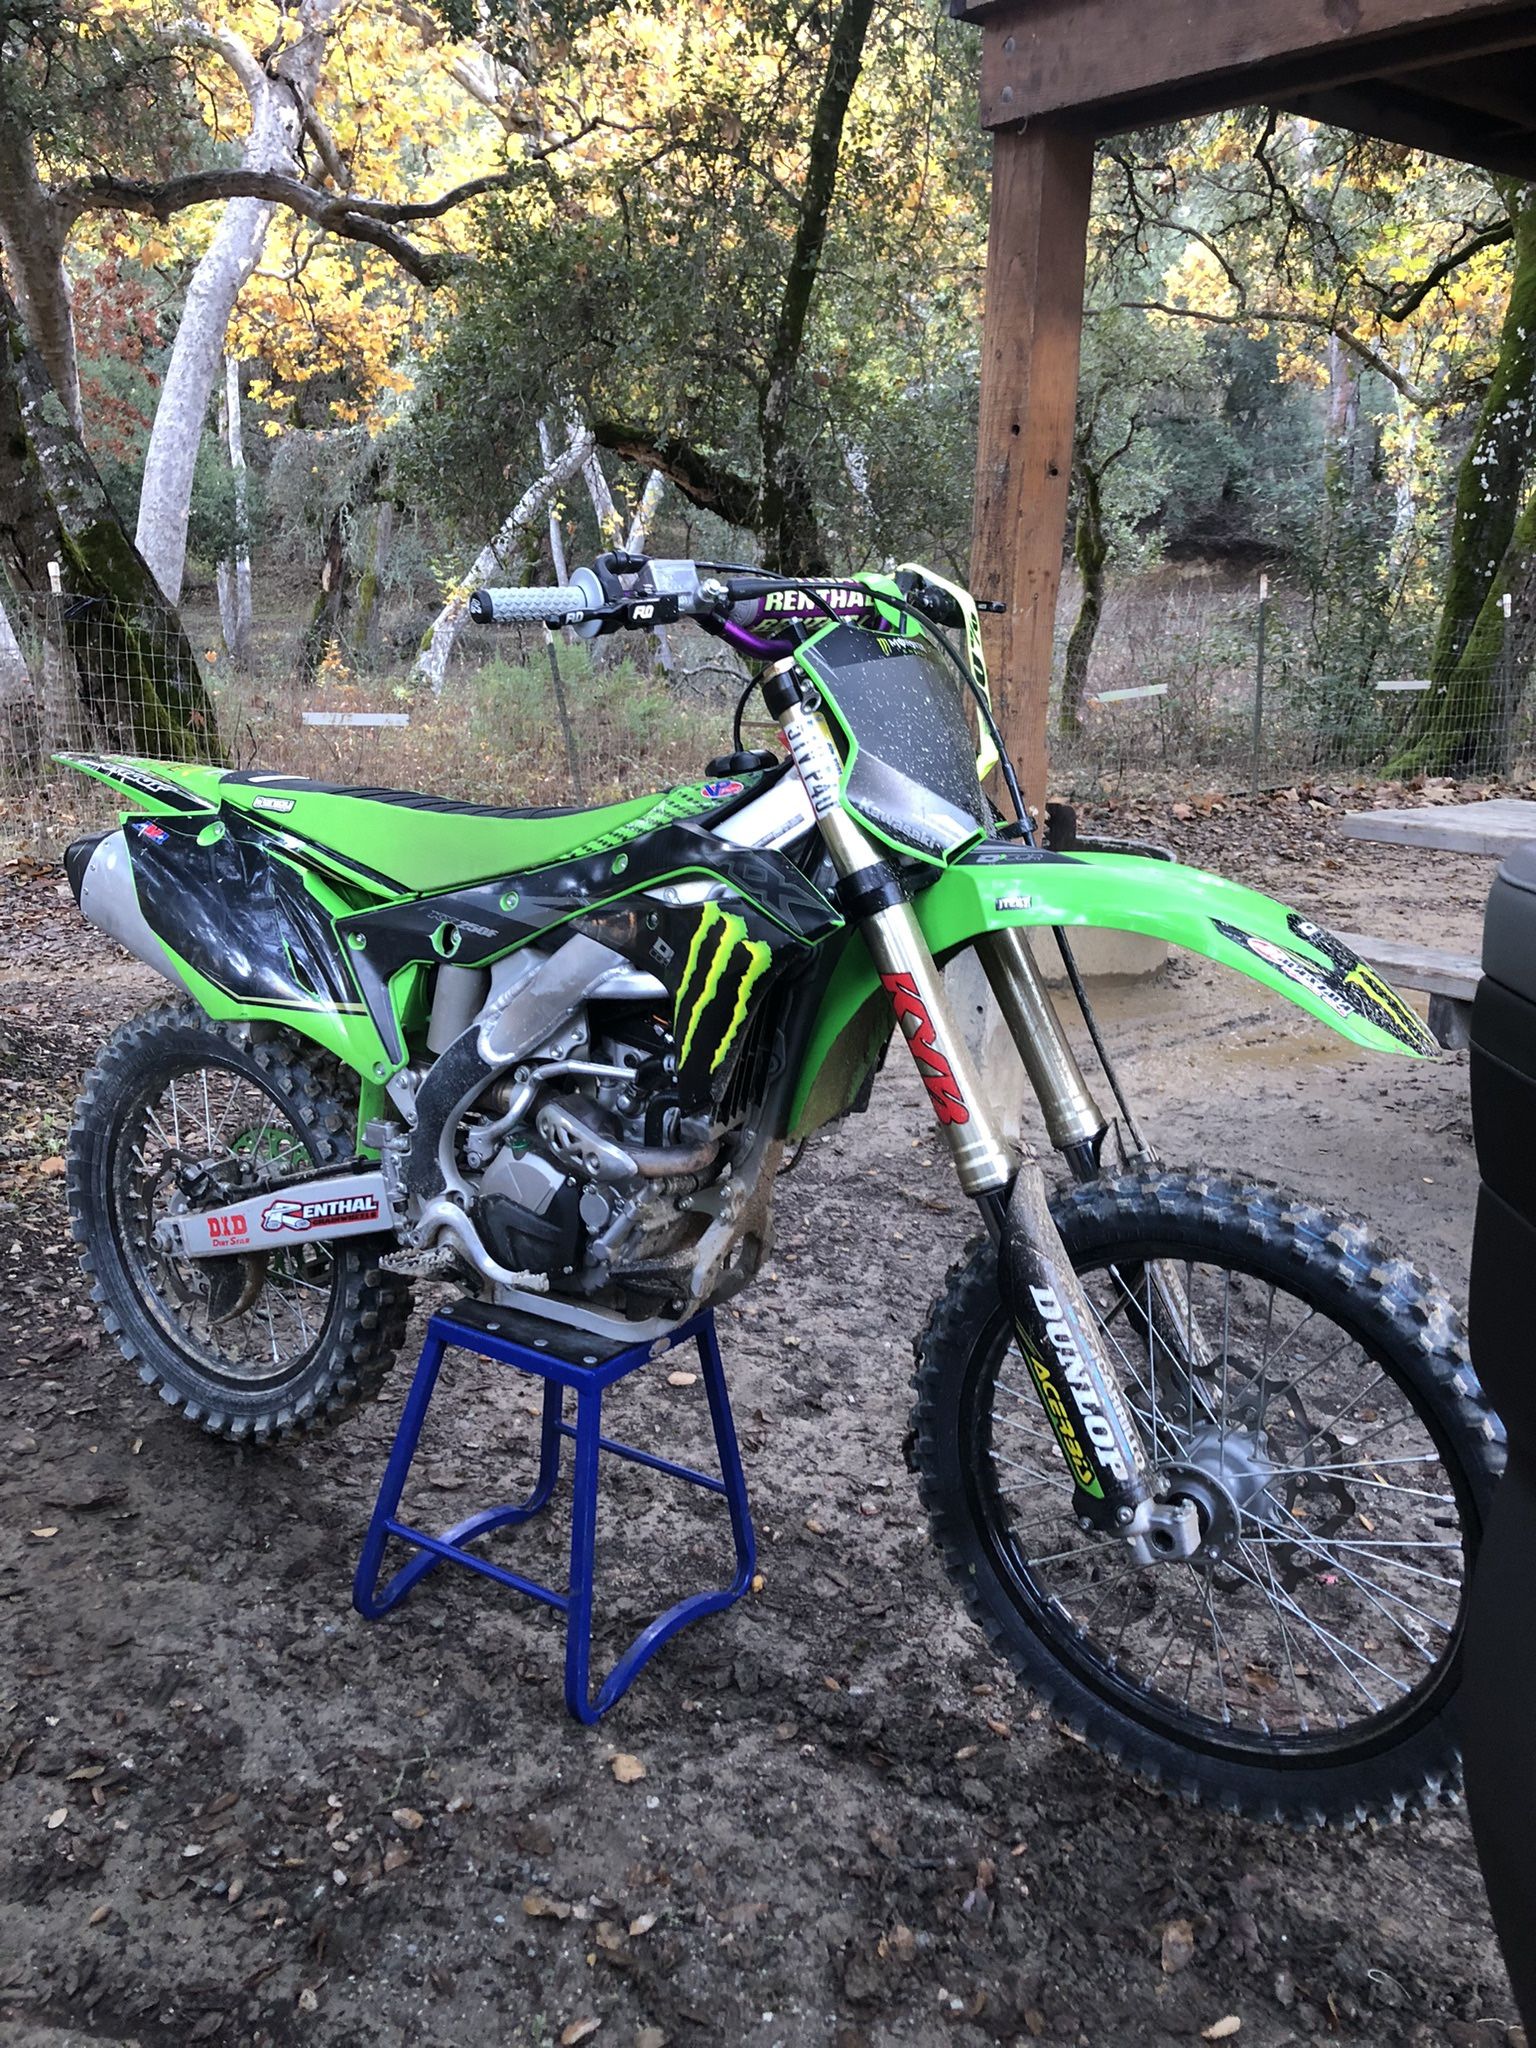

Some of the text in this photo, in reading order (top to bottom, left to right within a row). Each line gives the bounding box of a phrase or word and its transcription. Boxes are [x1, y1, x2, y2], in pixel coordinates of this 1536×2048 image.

[764, 588, 876, 612] RENTHAL
[1028, 1285, 1129, 1481] DUNLOP
[1031, 1356, 1095, 1485] ACERBIS
